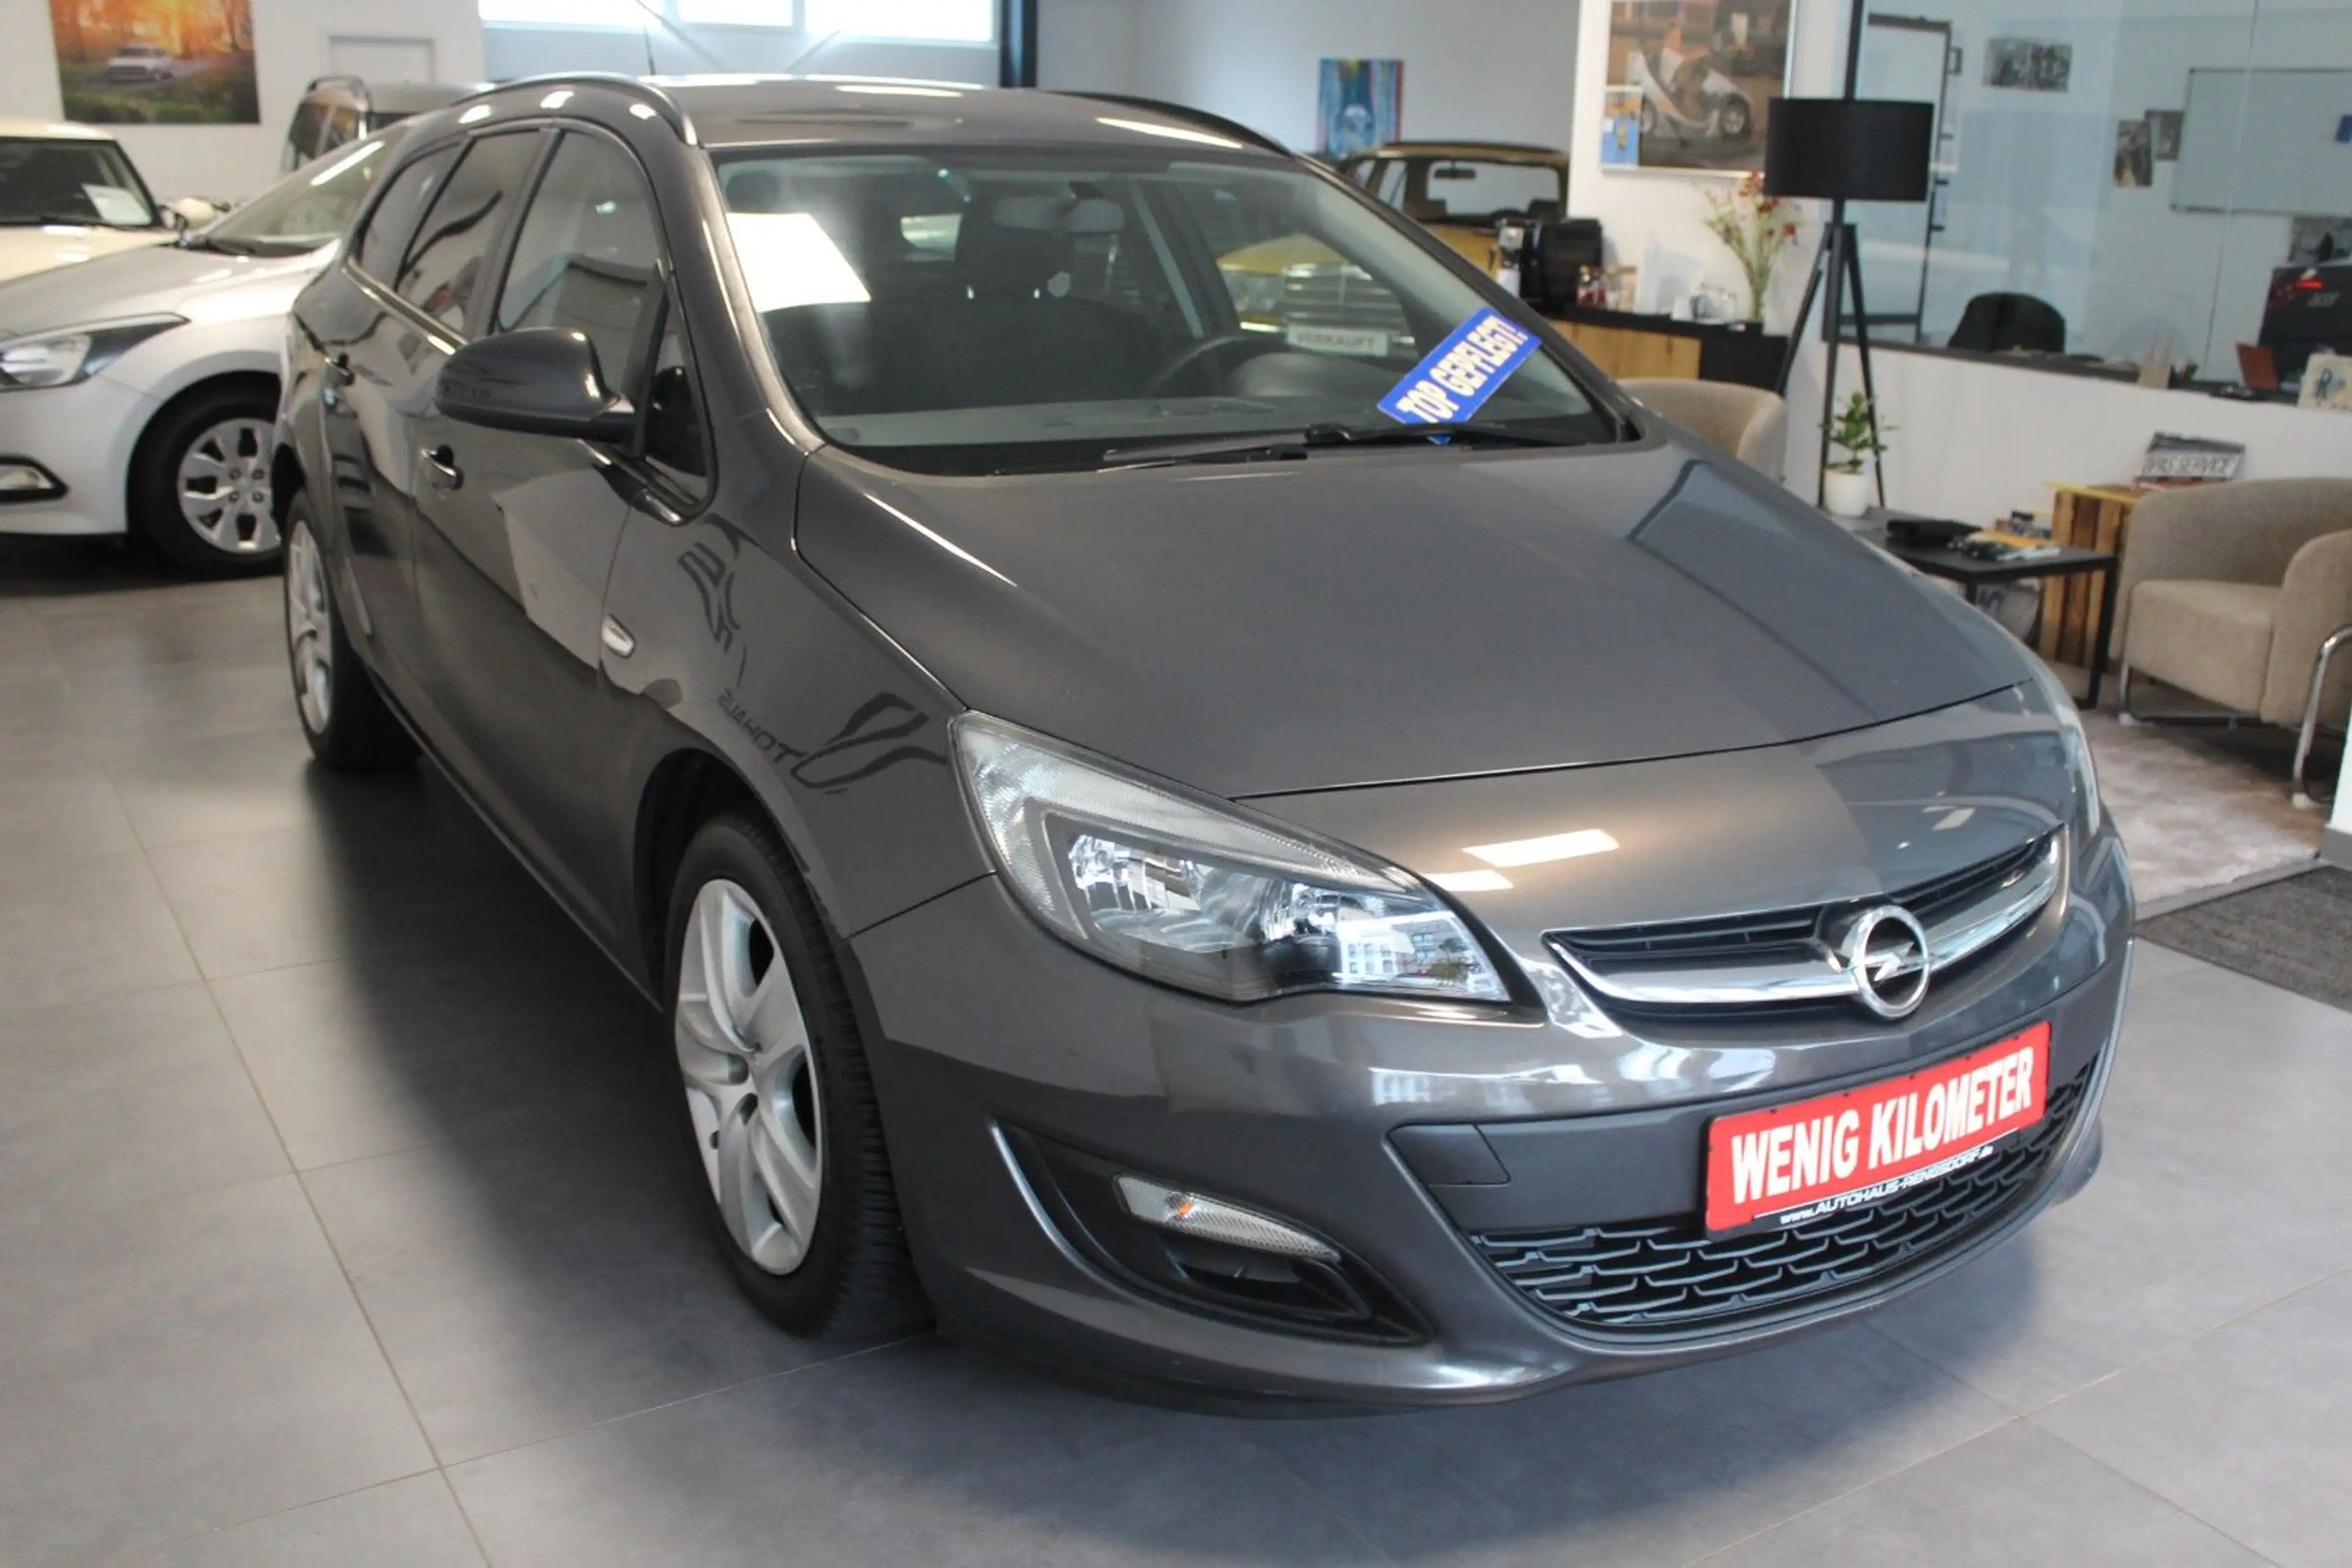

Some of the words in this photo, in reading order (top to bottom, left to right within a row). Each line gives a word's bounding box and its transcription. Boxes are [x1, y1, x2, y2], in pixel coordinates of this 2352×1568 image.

[1395, 379, 1460, 423] TOP
[1429, 315, 1528, 396] GEPFLEGT!
[1732, 1109, 1860, 1204] WENIG
[1868, 1046, 2034, 1170] KILOMETER
